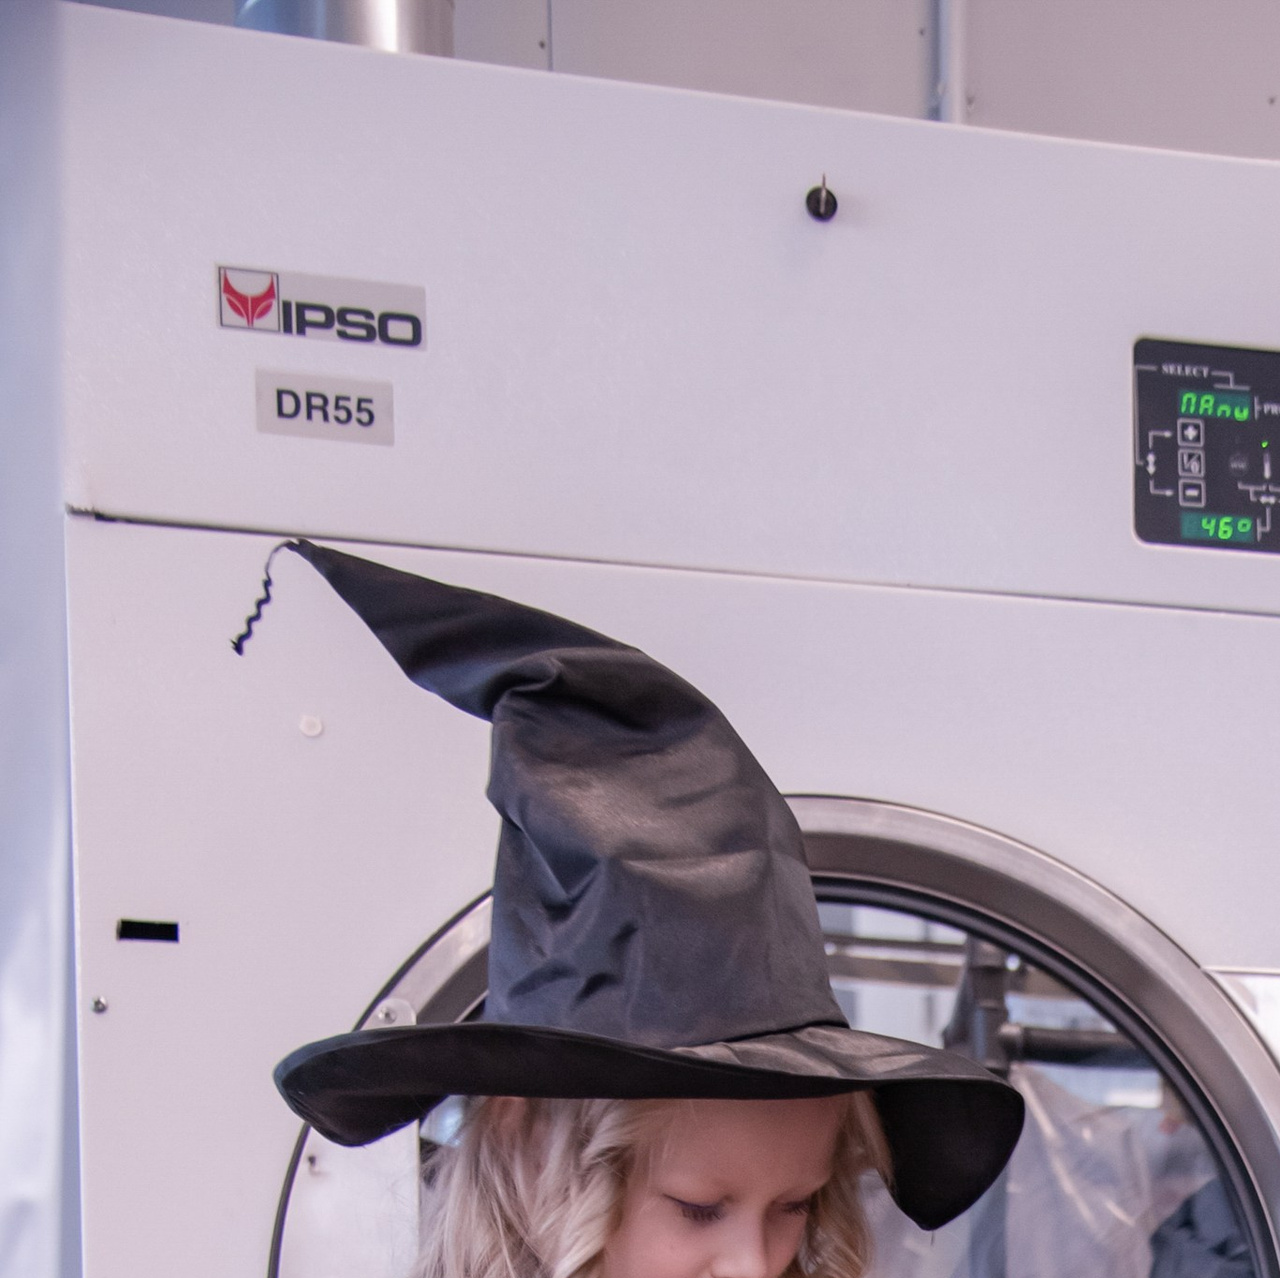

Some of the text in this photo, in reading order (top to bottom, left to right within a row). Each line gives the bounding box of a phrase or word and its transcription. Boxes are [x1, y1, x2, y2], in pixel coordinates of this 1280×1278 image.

[282, 299, 422, 347] IPSO
[1161, 363, 1209, 378] SELECT
[276, 388, 375, 427] DR55
